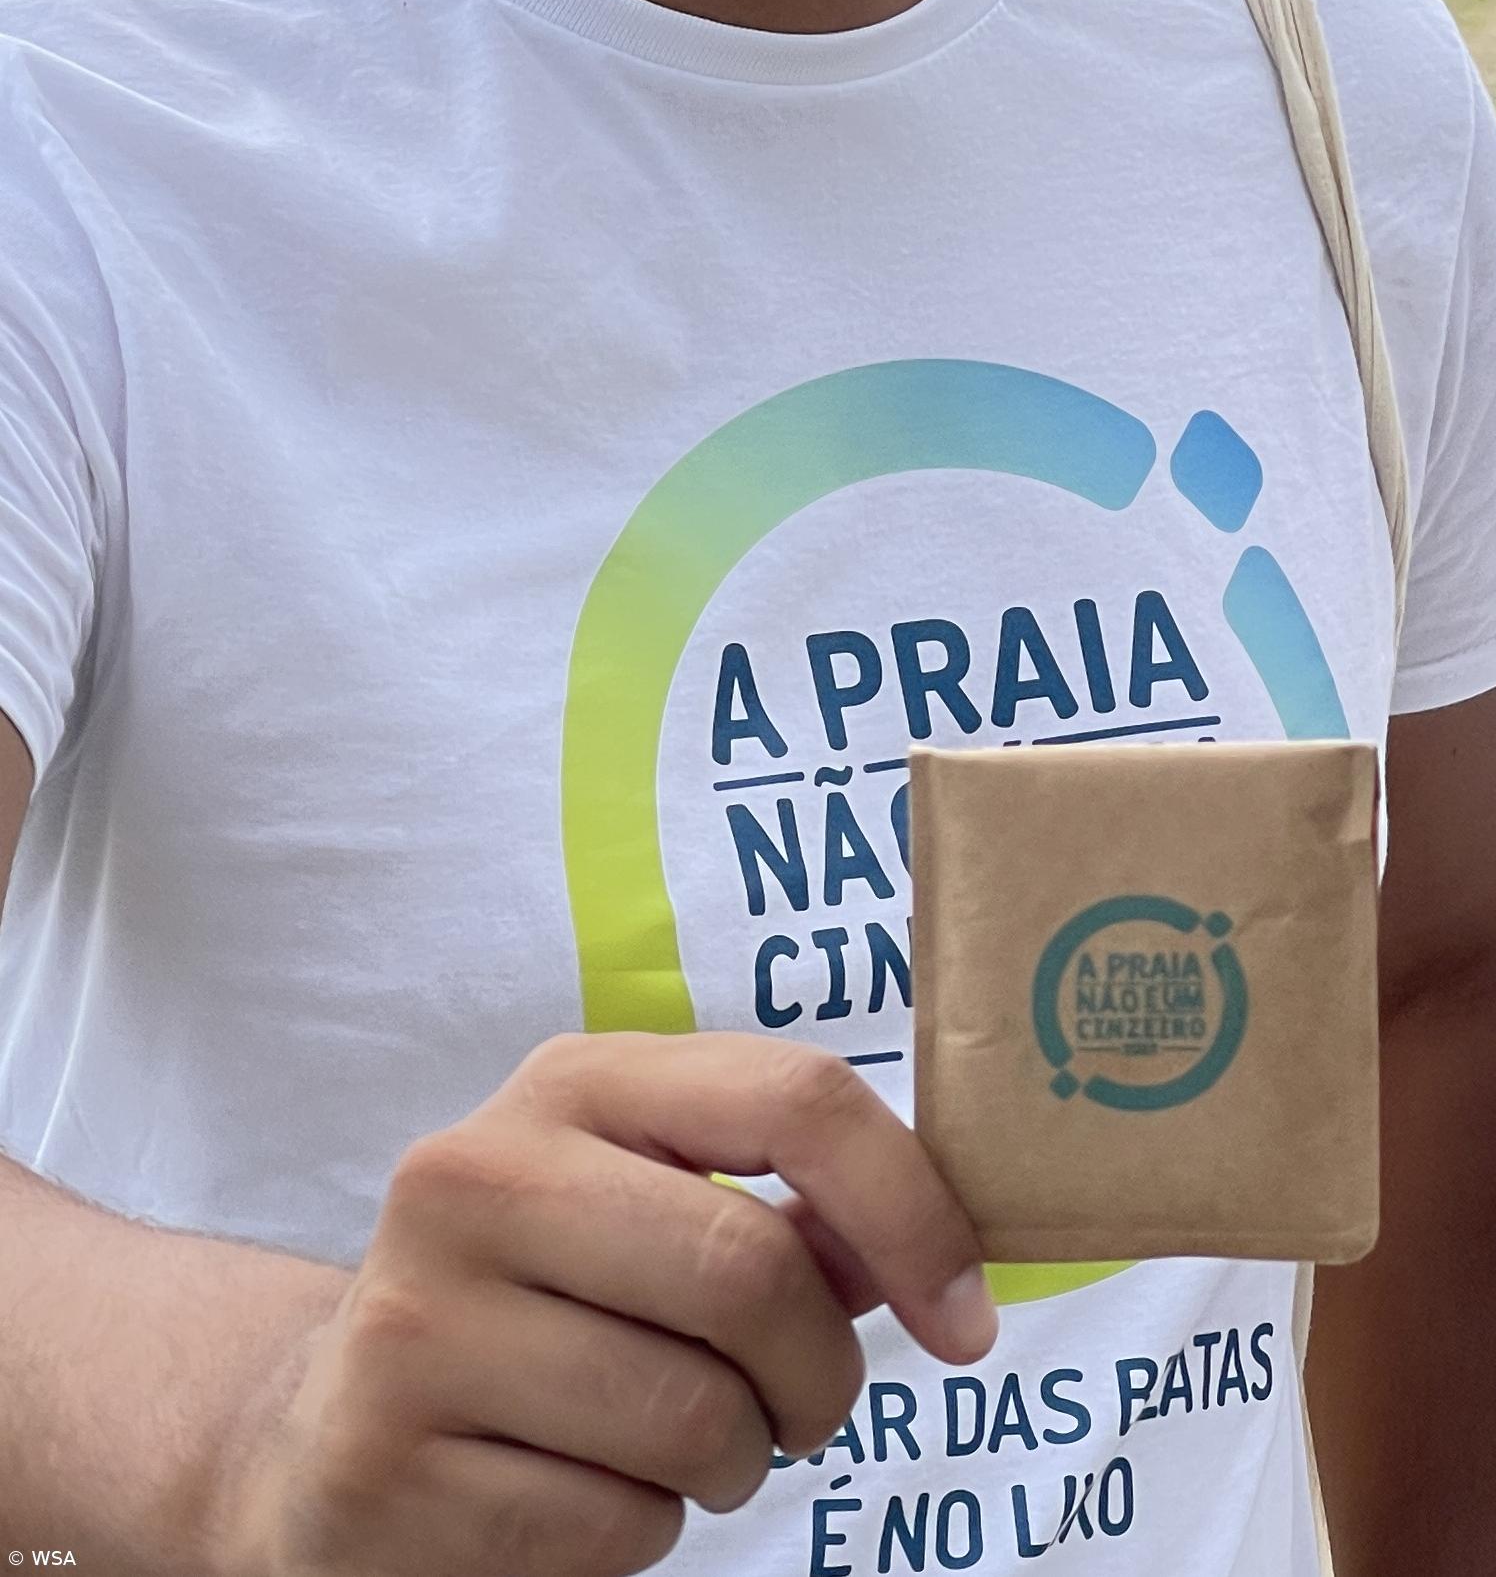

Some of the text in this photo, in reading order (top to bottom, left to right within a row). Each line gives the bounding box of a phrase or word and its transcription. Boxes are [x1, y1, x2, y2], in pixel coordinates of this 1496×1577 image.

[711, 590, 1210, 765] A PRAIA
[1078, 951, 1202, 980] A PRAIA
[1077, 1017, 1206, 1040] CINZEIRO
[943, 1368, 1092, 1457] DAS
[809, 1474, 863, 1577] É
[878, 1489, 984, 1574] NO
